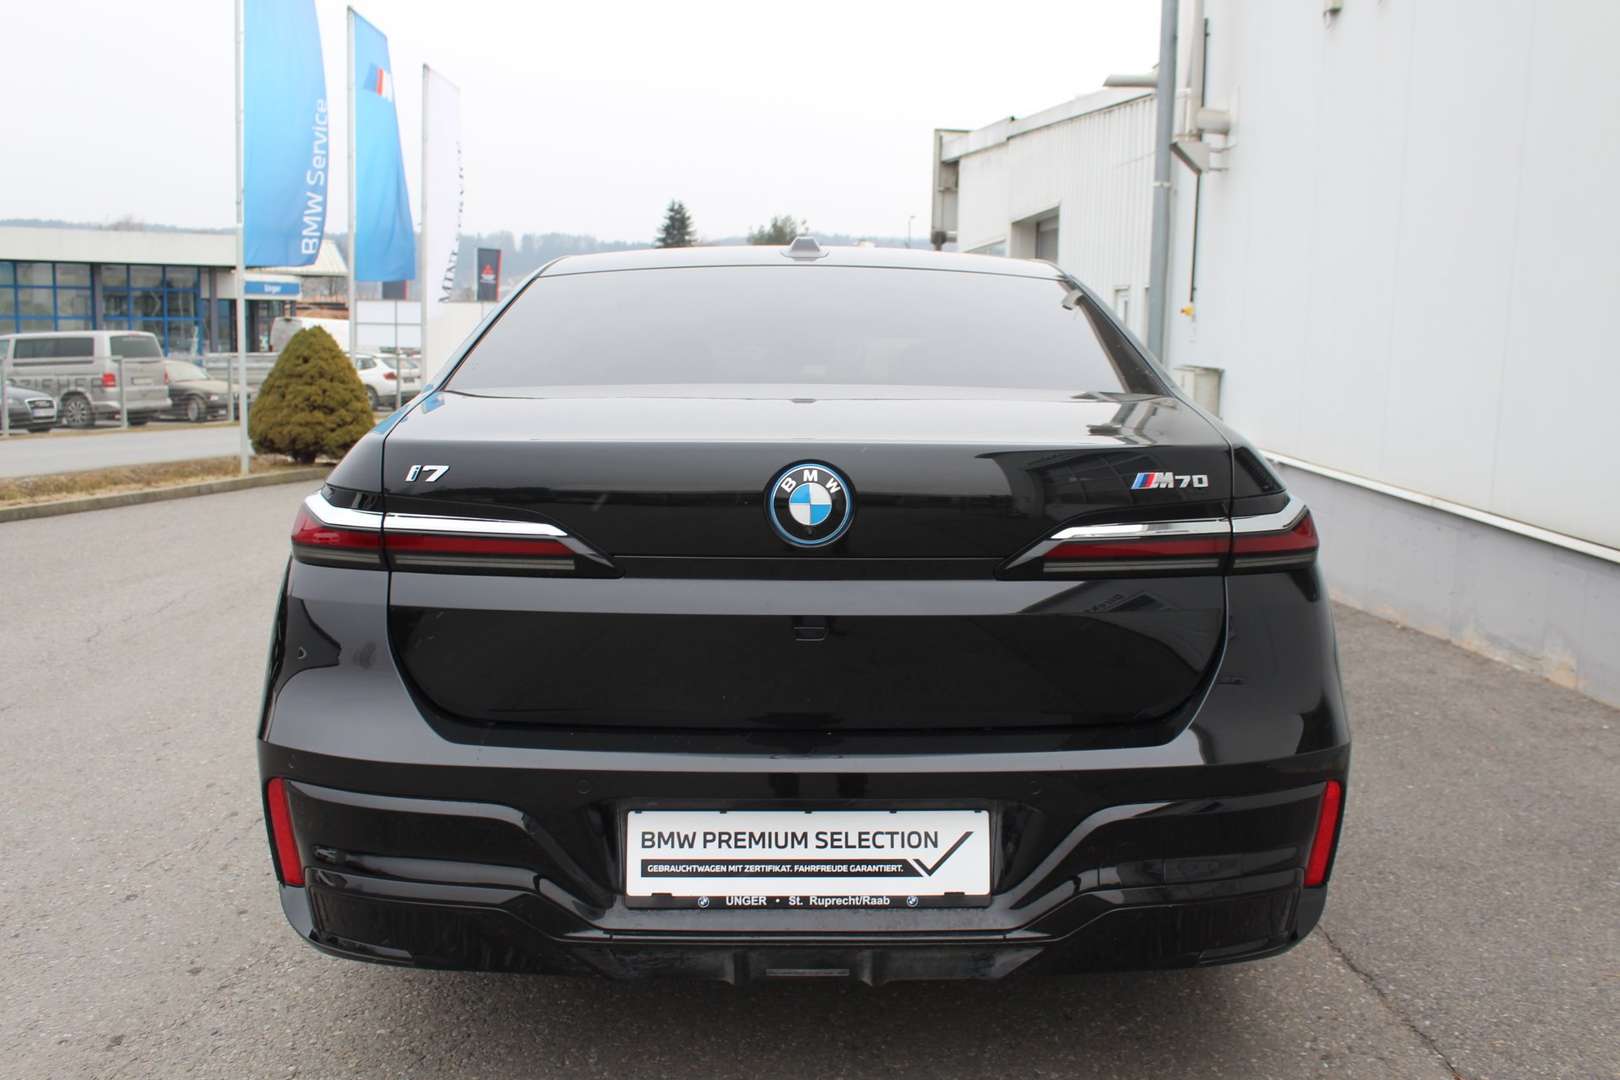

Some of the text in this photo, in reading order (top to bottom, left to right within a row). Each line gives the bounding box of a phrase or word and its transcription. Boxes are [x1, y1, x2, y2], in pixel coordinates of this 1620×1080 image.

[301, 98, 329, 255] BMW Service
[780, 468, 843, 495] BMW
[640, 830, 939, 850] BMW PREMIUM SELECTION
[647, 864, 904, 873] GEBRAUCHTWAGEN MIT ZERTIFIKAT. FAHRFREUDE GARANTIERT.
[725, 896, 890, 908] UNGER St. Ruprecht/Raab
